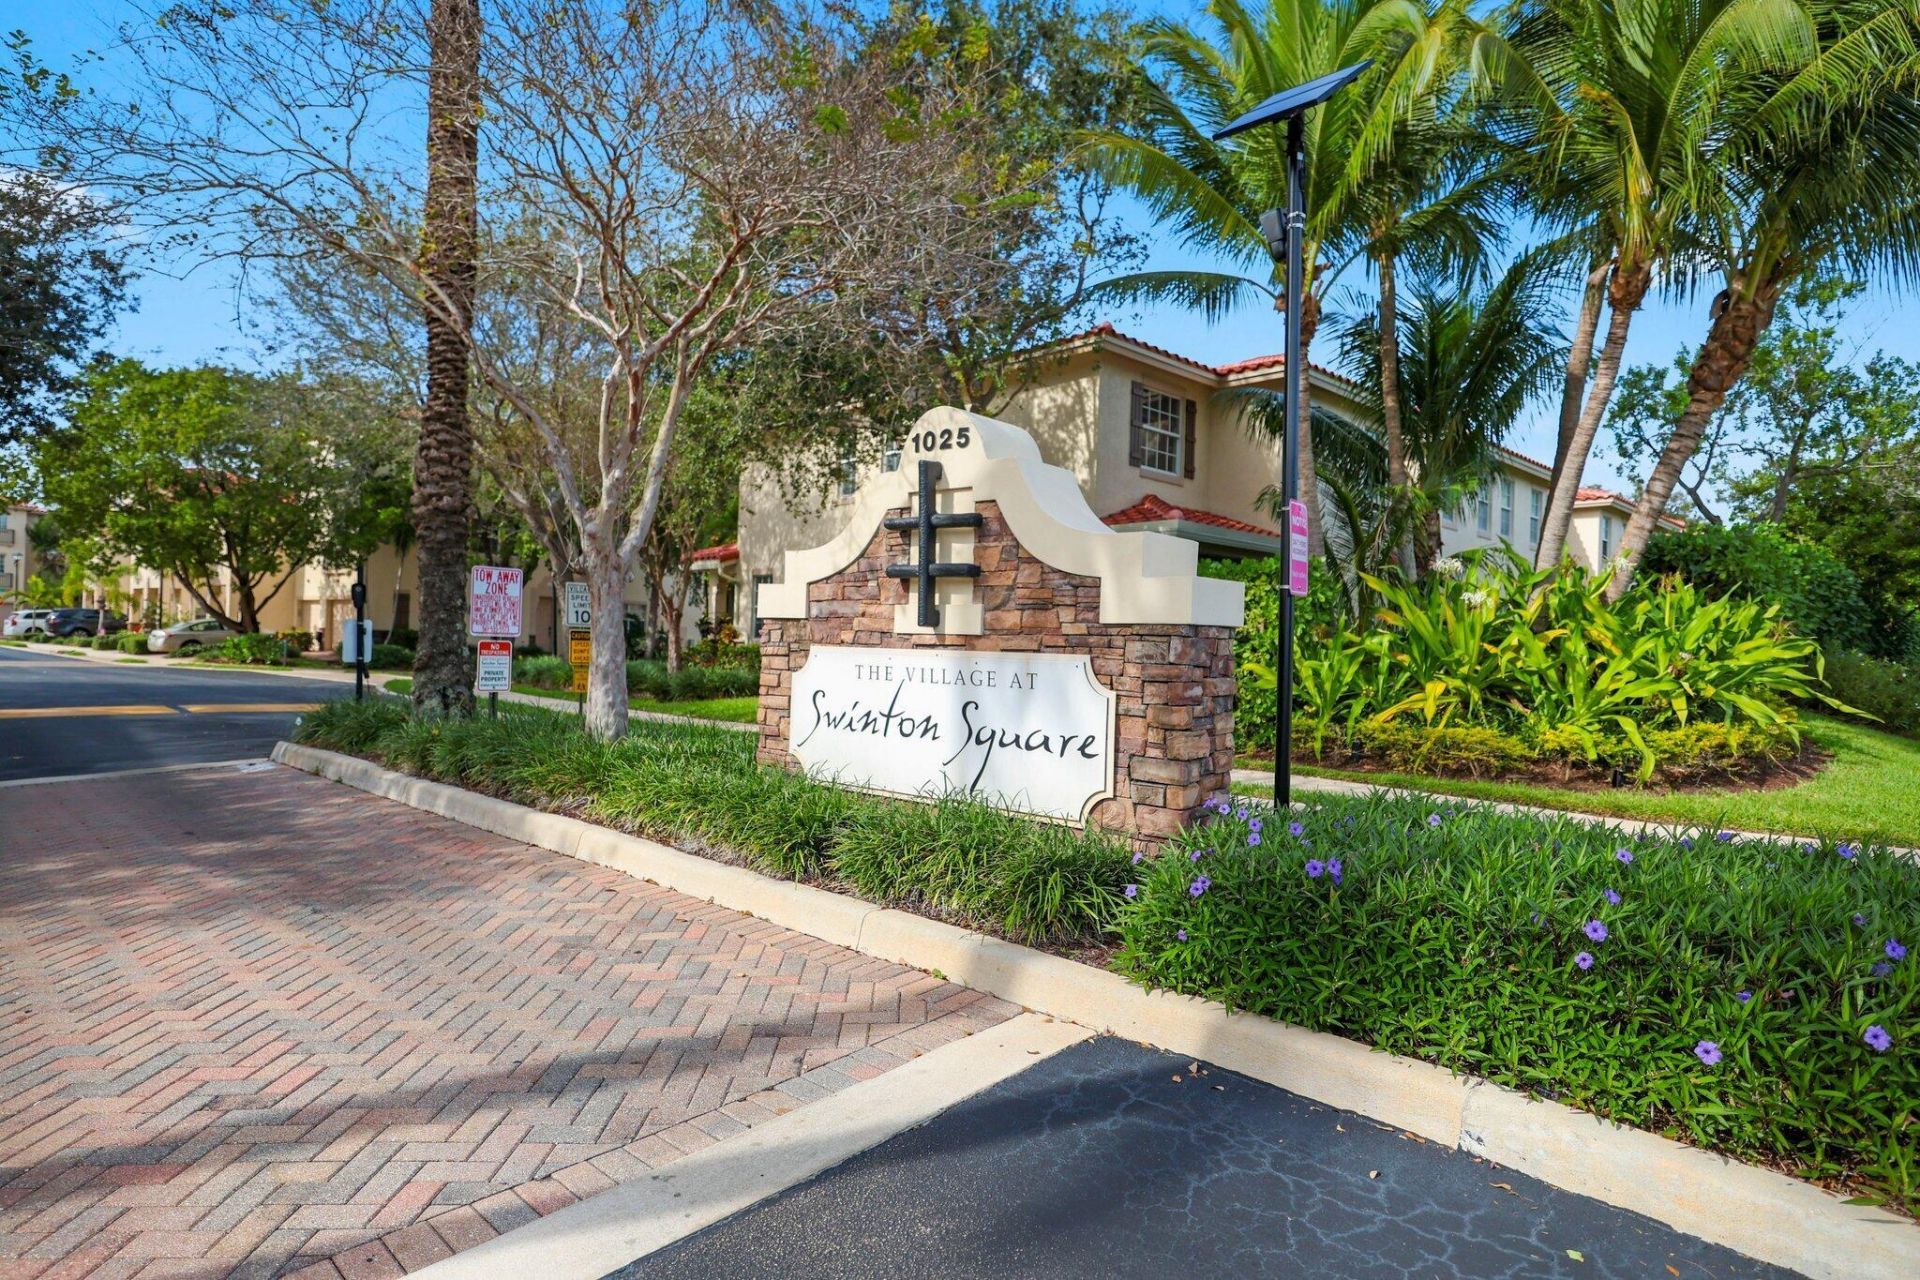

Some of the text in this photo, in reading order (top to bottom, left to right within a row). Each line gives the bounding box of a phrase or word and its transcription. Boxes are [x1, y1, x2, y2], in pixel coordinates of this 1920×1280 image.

[912, 427, 970, 453] 1025
[475, 569, 519, 584] TOW AWAY
[485, 582, 508, 595] ZONE
[574, 610, 591, 623] 10
[855, 664, 1038, 690] THE VILLAGE AT
[797, 679, 1099, 795] Swinton Square
